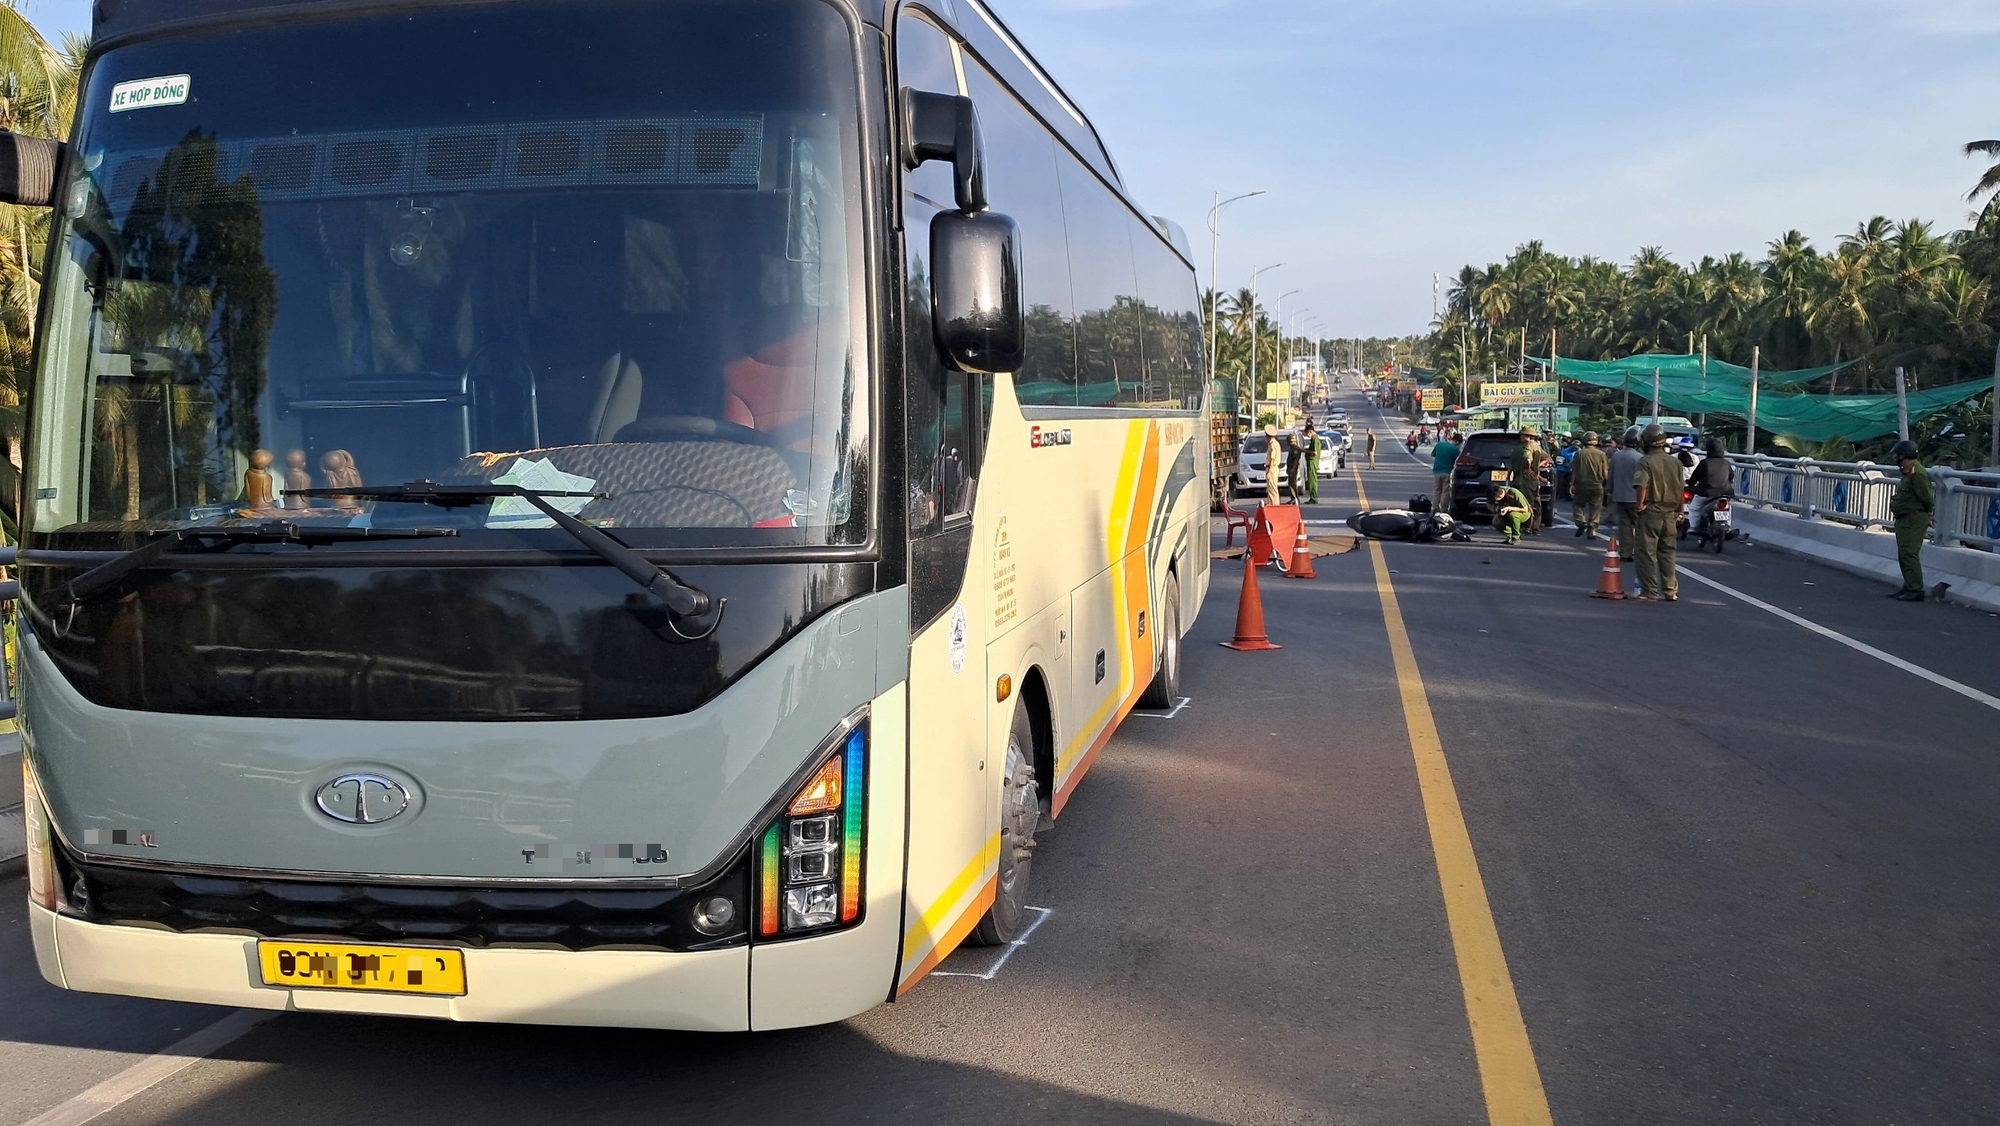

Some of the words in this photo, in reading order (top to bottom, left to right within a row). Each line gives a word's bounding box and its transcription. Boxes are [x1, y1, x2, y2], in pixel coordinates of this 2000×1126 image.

[113, 91, 127, 107] XE
[129, 86, 151, 106] HỢP
[153, 80, 185, 100] ĐỒNG
[1484, 387, 1499, 396] BÃI
[1501, 385, 1517, 395] GIỮ
[1518, 387, 1530, 395] XE
